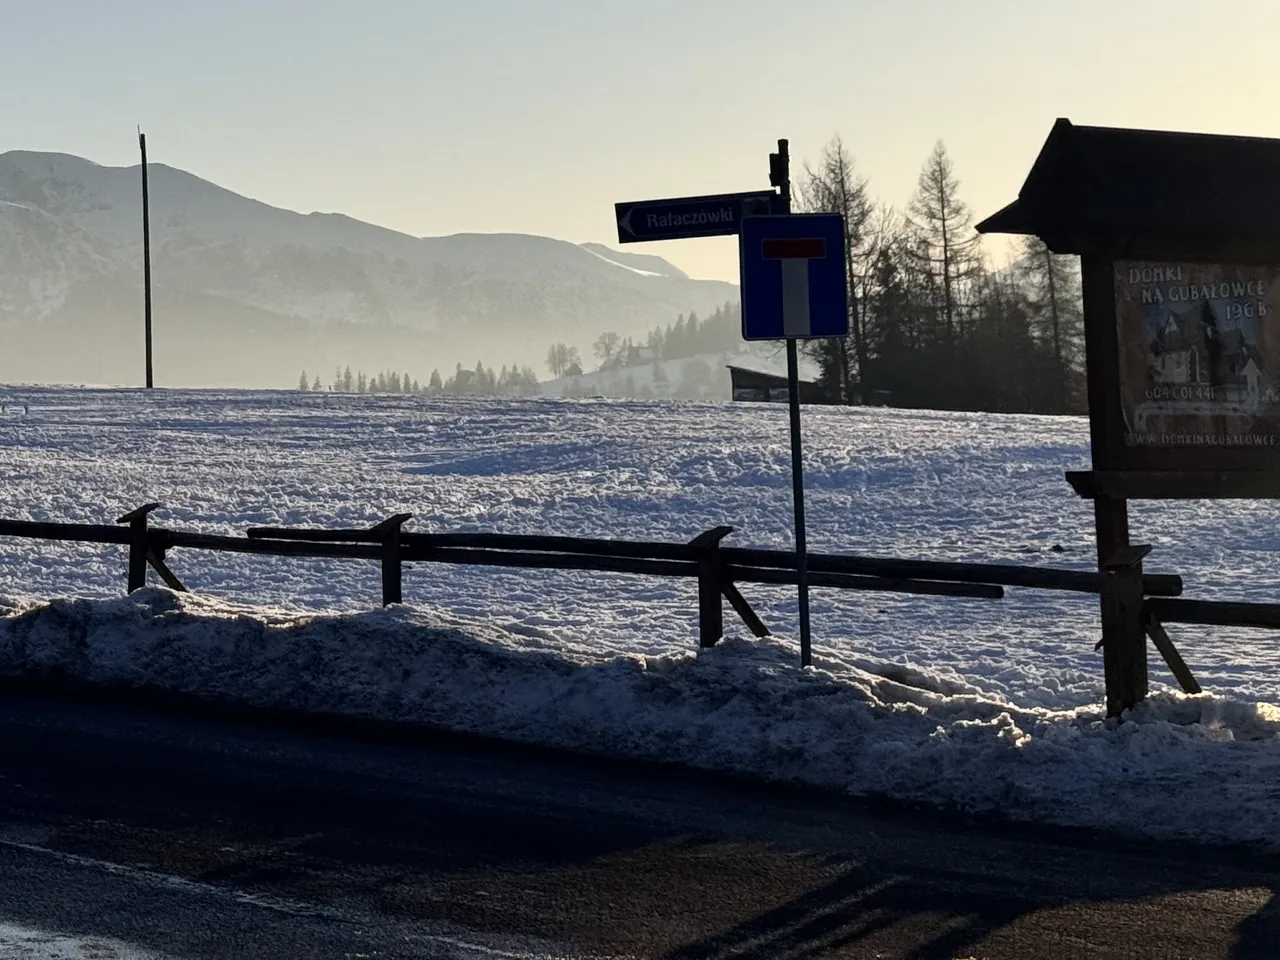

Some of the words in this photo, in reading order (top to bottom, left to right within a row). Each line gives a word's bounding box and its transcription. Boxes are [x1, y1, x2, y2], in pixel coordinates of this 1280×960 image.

[646, 206, 734, 228] Rafaczówki
[1128, 265, 1182, 285] DOMKI
[1141, 286, 1164, 305] NA
[1225, 301, 1254, 320] 196
[1257, 300, 1267, 317] B
